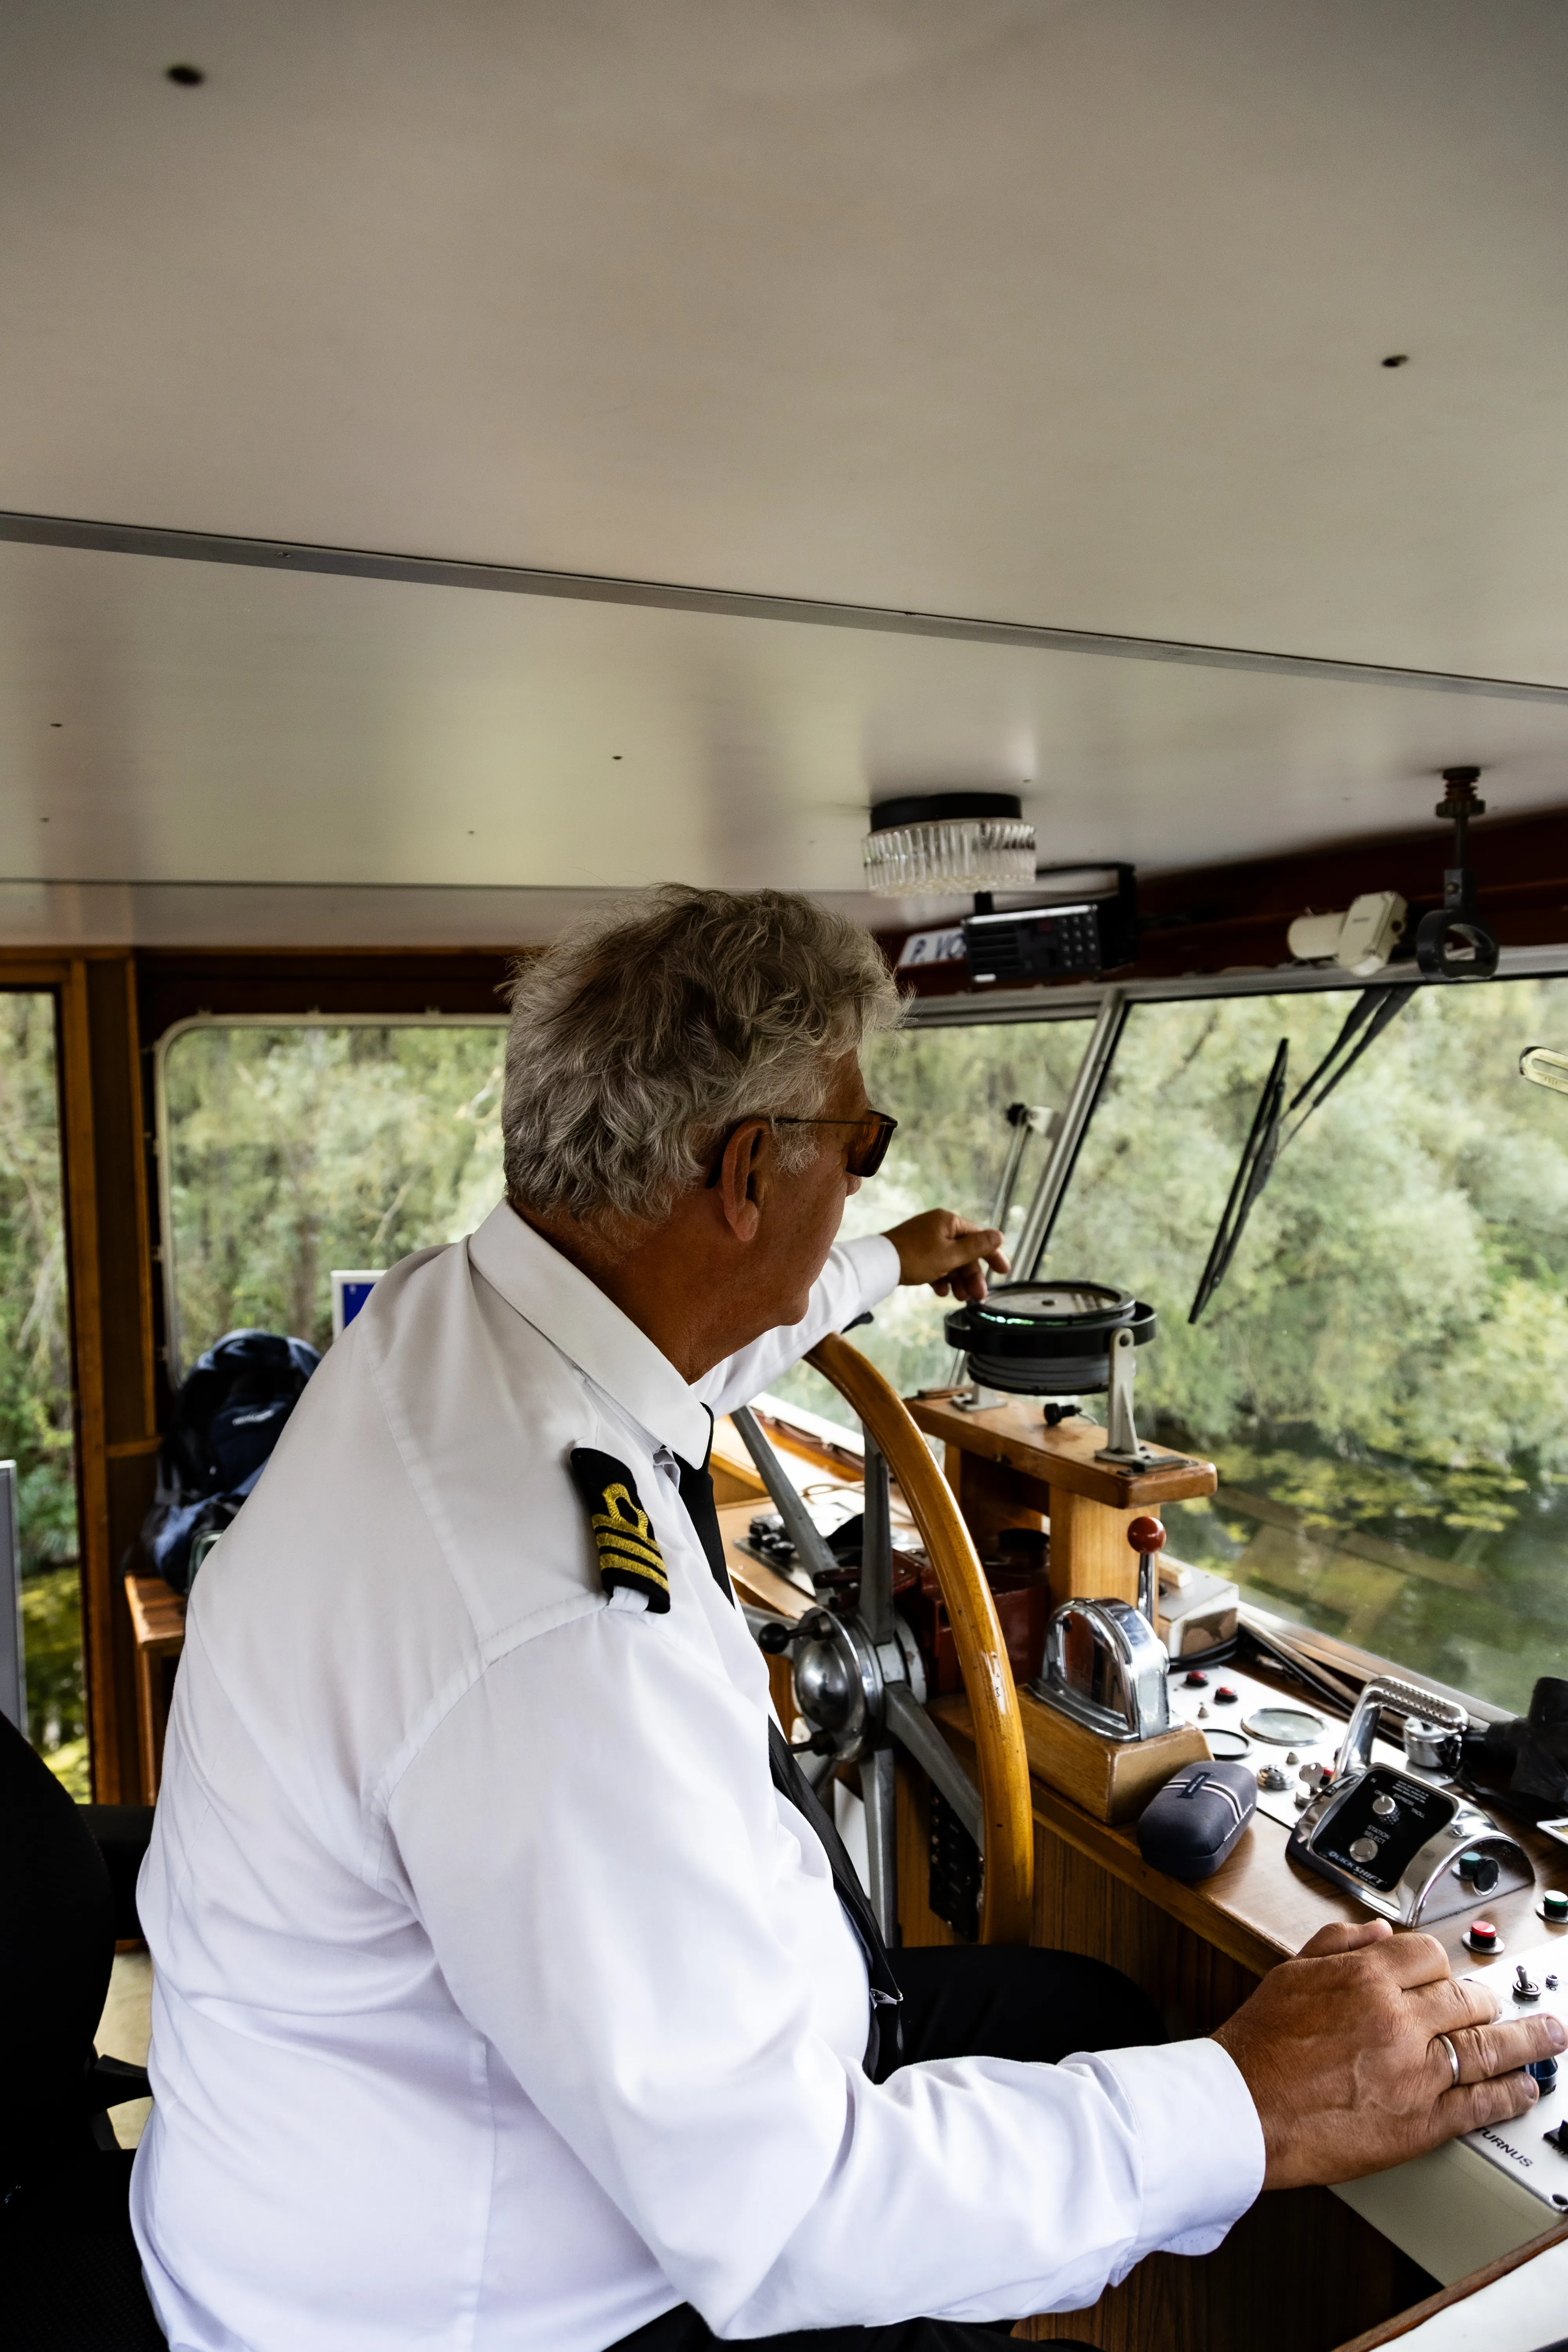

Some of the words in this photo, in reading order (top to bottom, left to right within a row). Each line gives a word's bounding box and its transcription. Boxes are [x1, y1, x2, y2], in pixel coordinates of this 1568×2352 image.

[1412, 1807, 1425, 1819] TROLL
[1364, 1830, 1386, 1844] SELECT
[1367, 1825, 1391, 1840] STATION
[1328, 1851, 1355, 1868] QUICK
[1353, 1866, 1385, 1884] SHIFT
